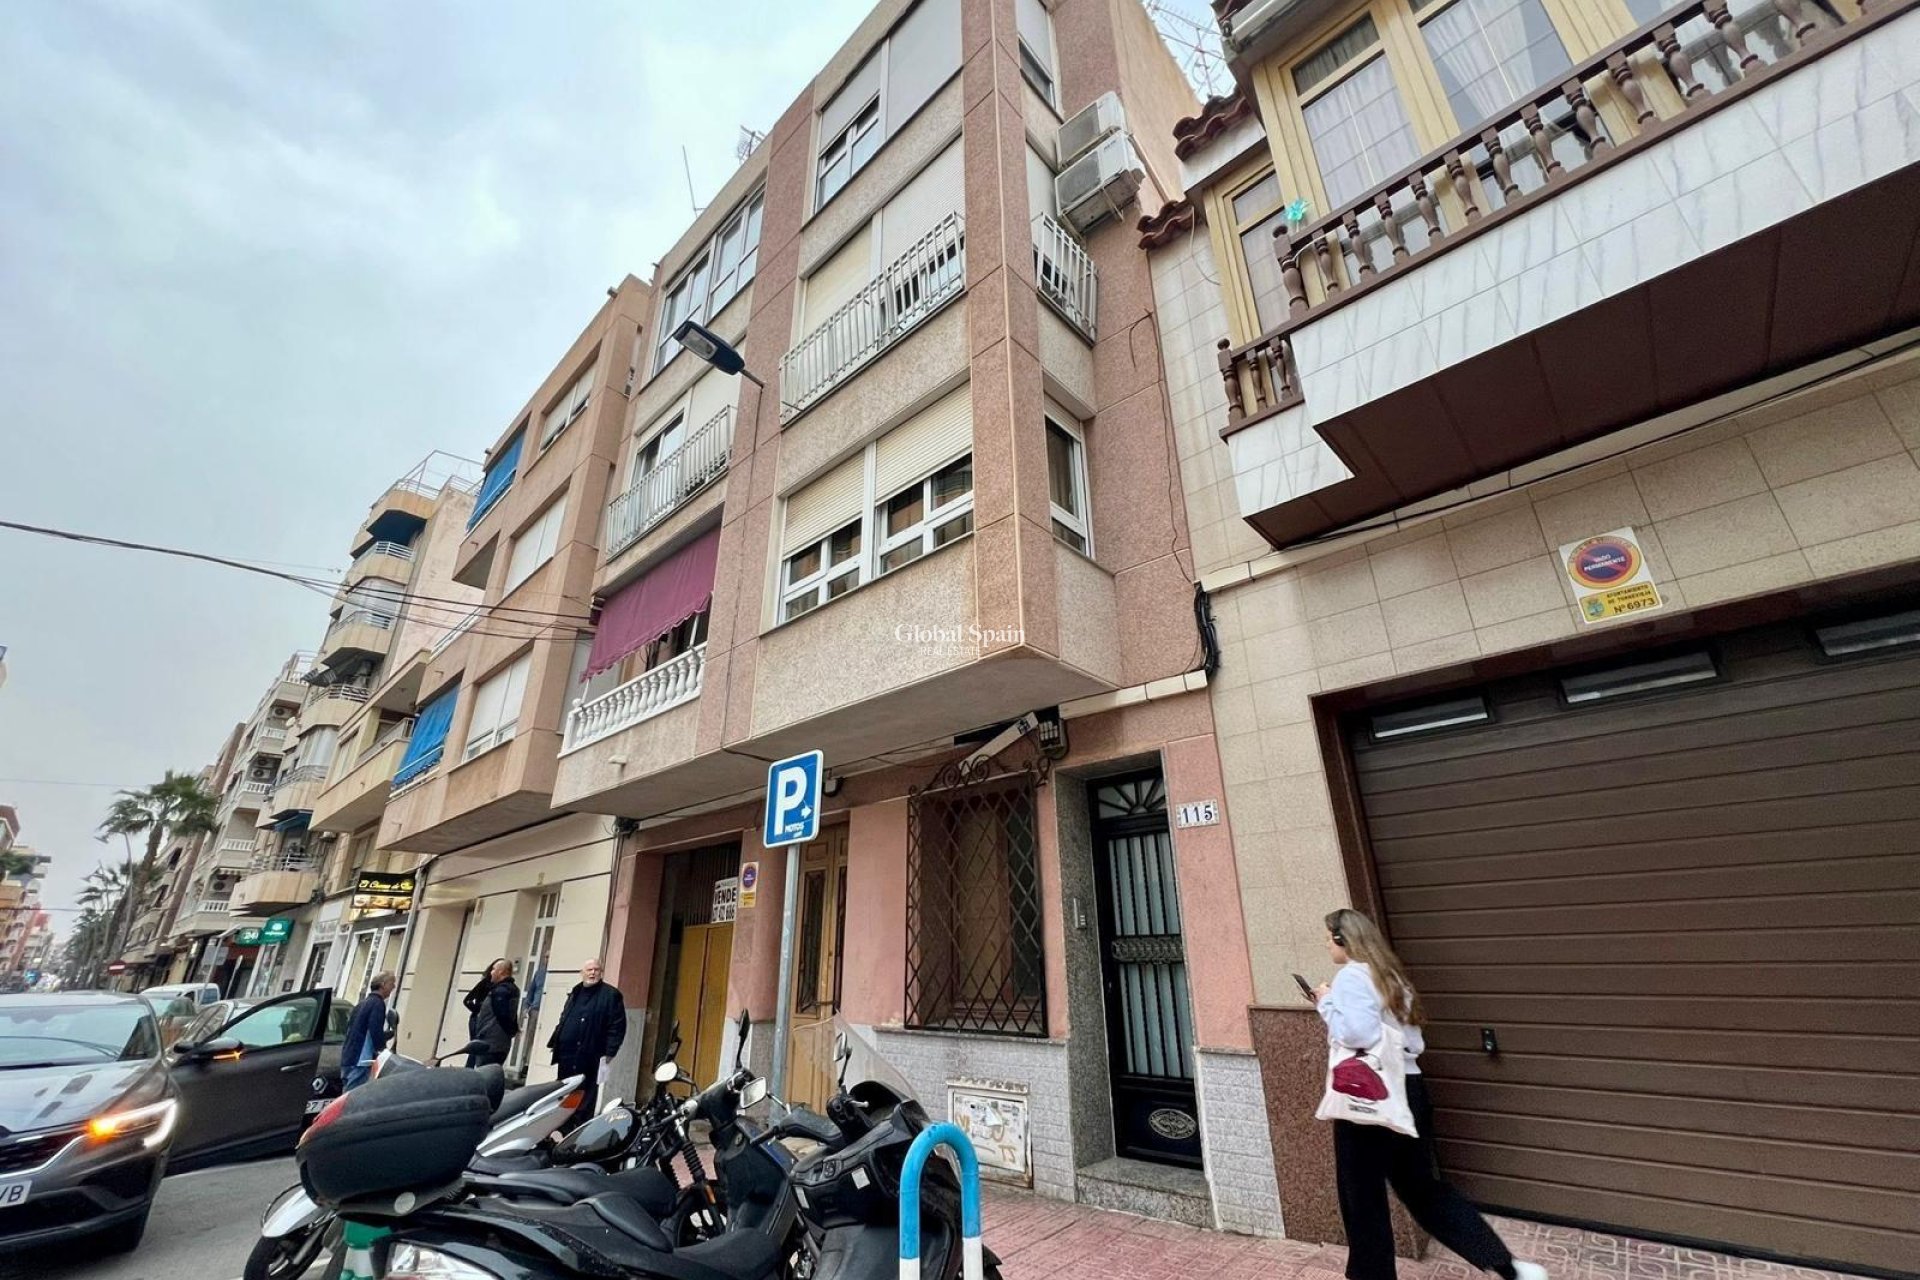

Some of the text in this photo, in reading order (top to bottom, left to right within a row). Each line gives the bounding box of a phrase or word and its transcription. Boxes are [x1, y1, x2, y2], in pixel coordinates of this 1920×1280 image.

[774, 766, 808, 836] P
[1182, 804, 1213, 824] 115
[714, 887, 738, 906] VENDE
